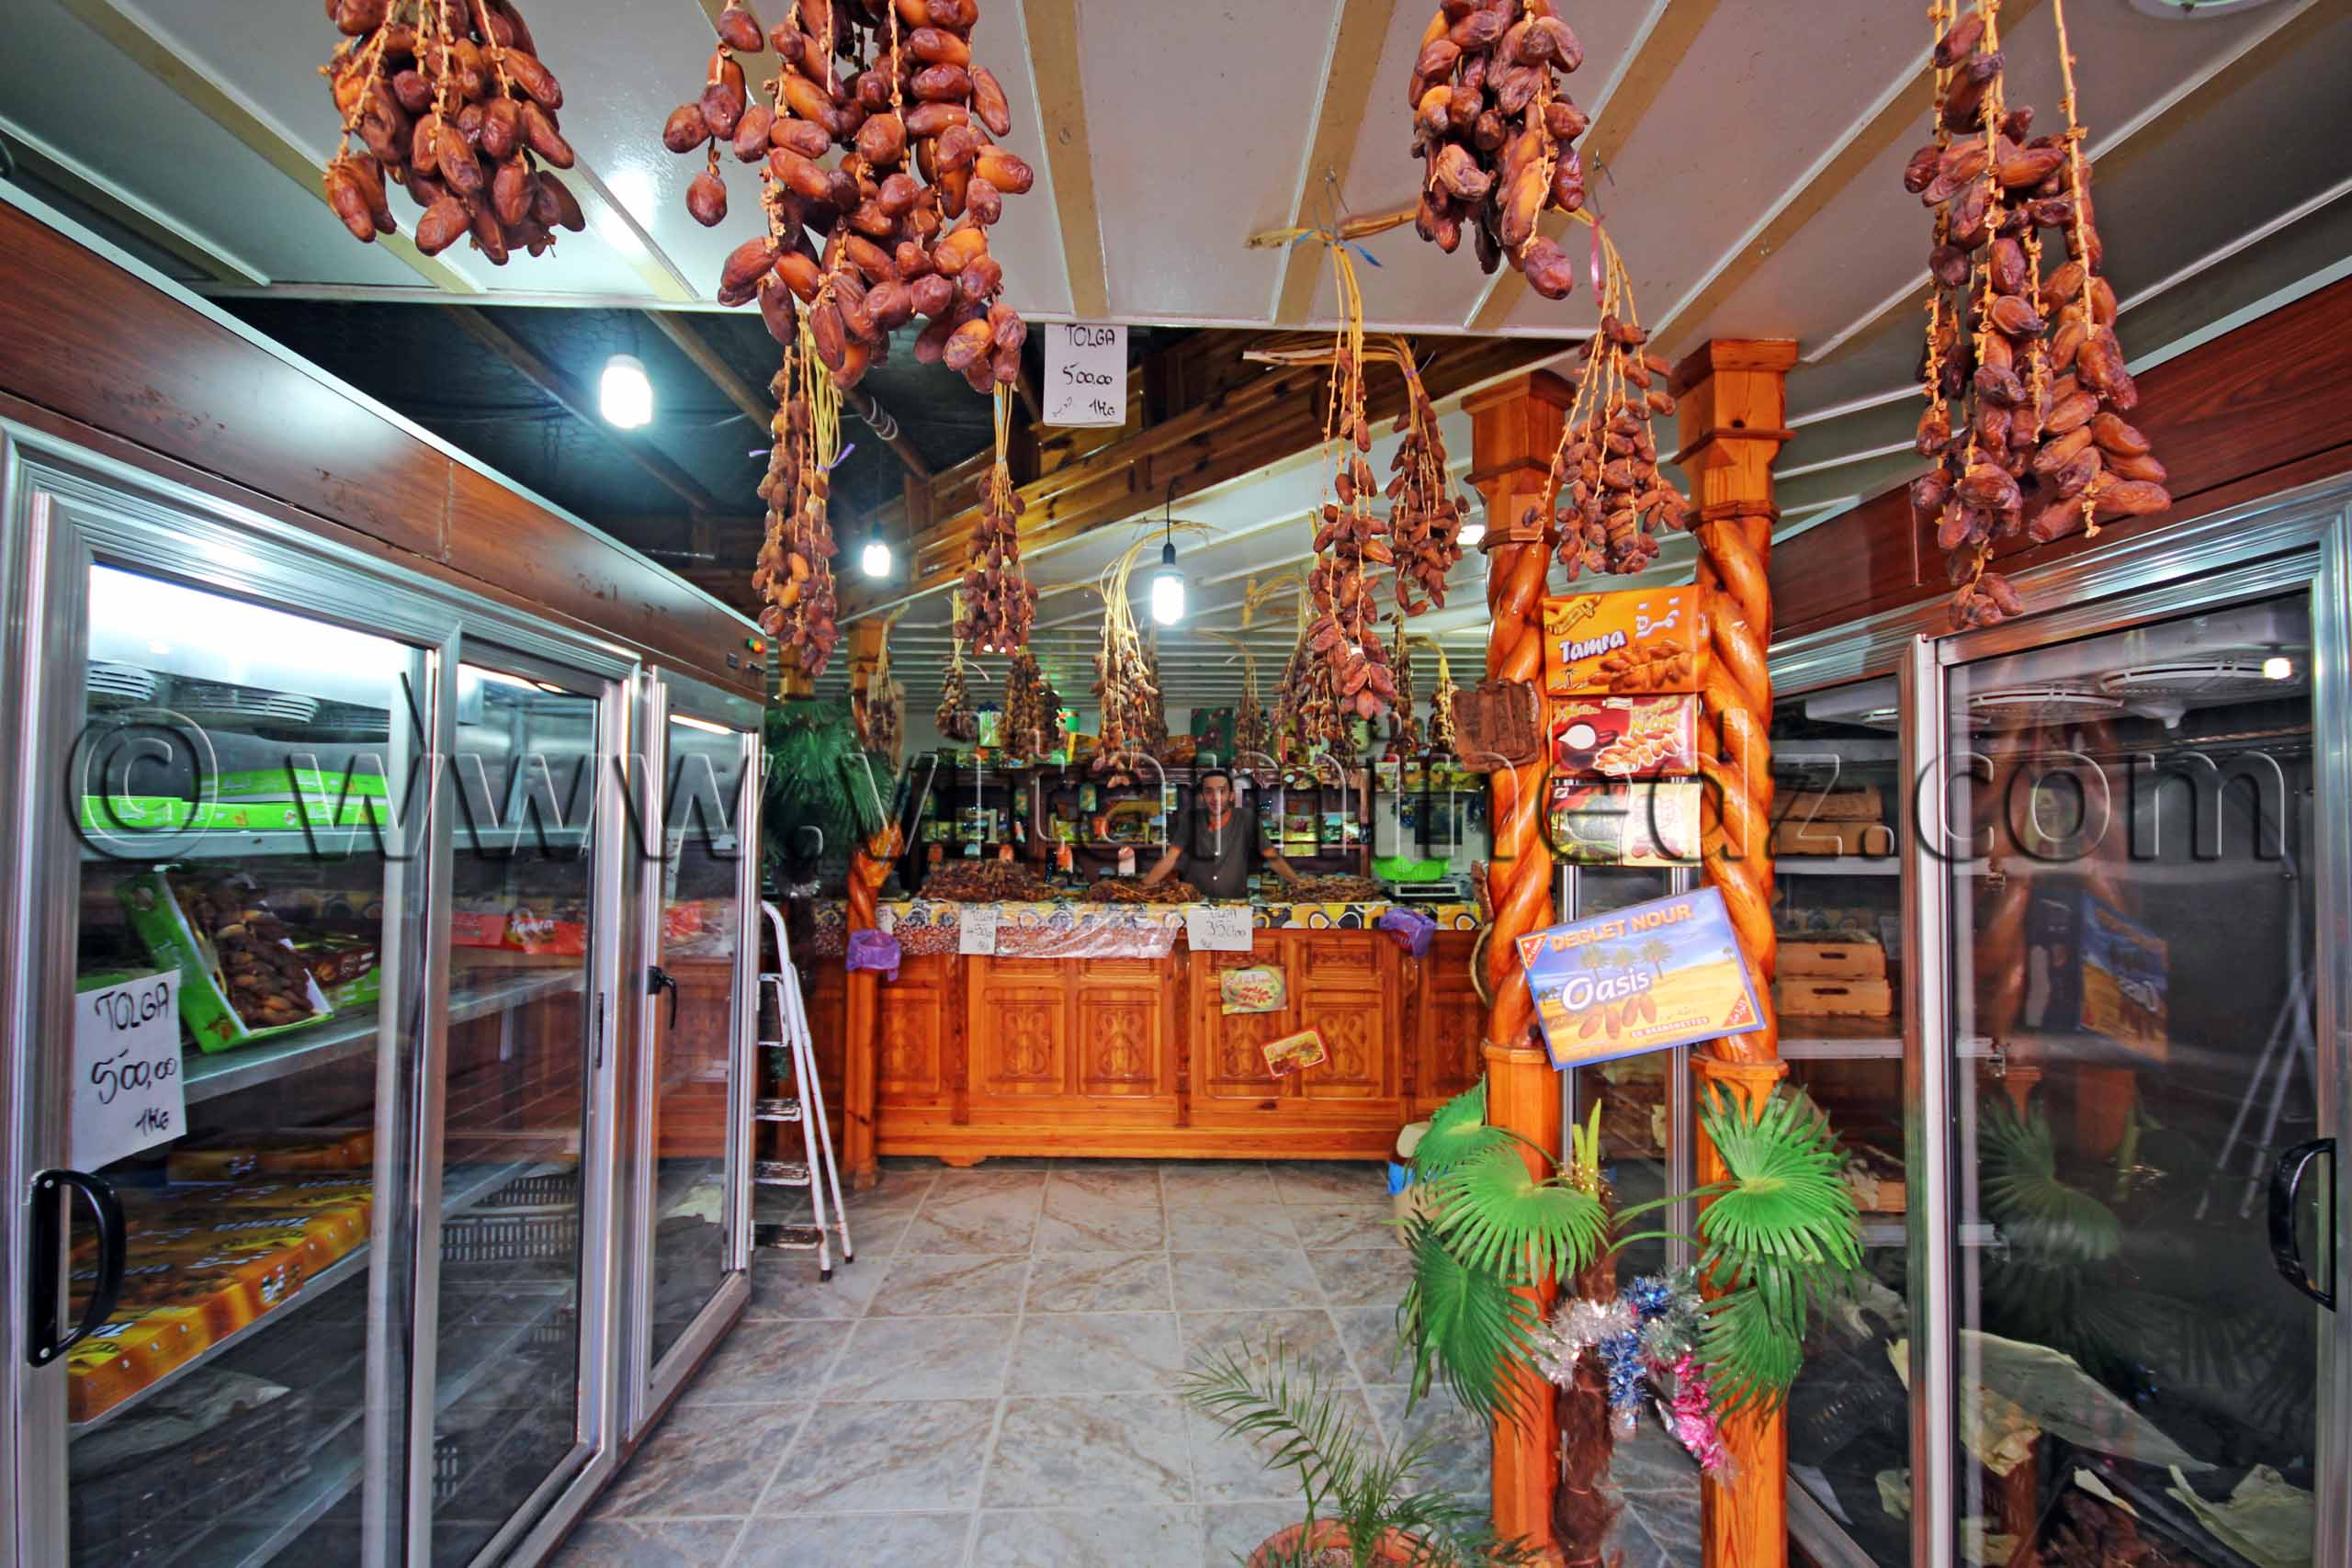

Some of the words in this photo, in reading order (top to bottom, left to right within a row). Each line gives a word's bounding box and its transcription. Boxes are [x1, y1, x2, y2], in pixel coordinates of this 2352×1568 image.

[1064, 323, 1115, 348] TOLGA
[1634, 596, 1680, 638] تمرة
[1559, 629, 1626, 664] Tamra
[1551, 919, 1626, 953] DEGLET
[1631, 903, 1692, 931] NOUR
[95, 981, 170, 1032] TOLGA
[1562, 969, 1650, 1010] Oasis
